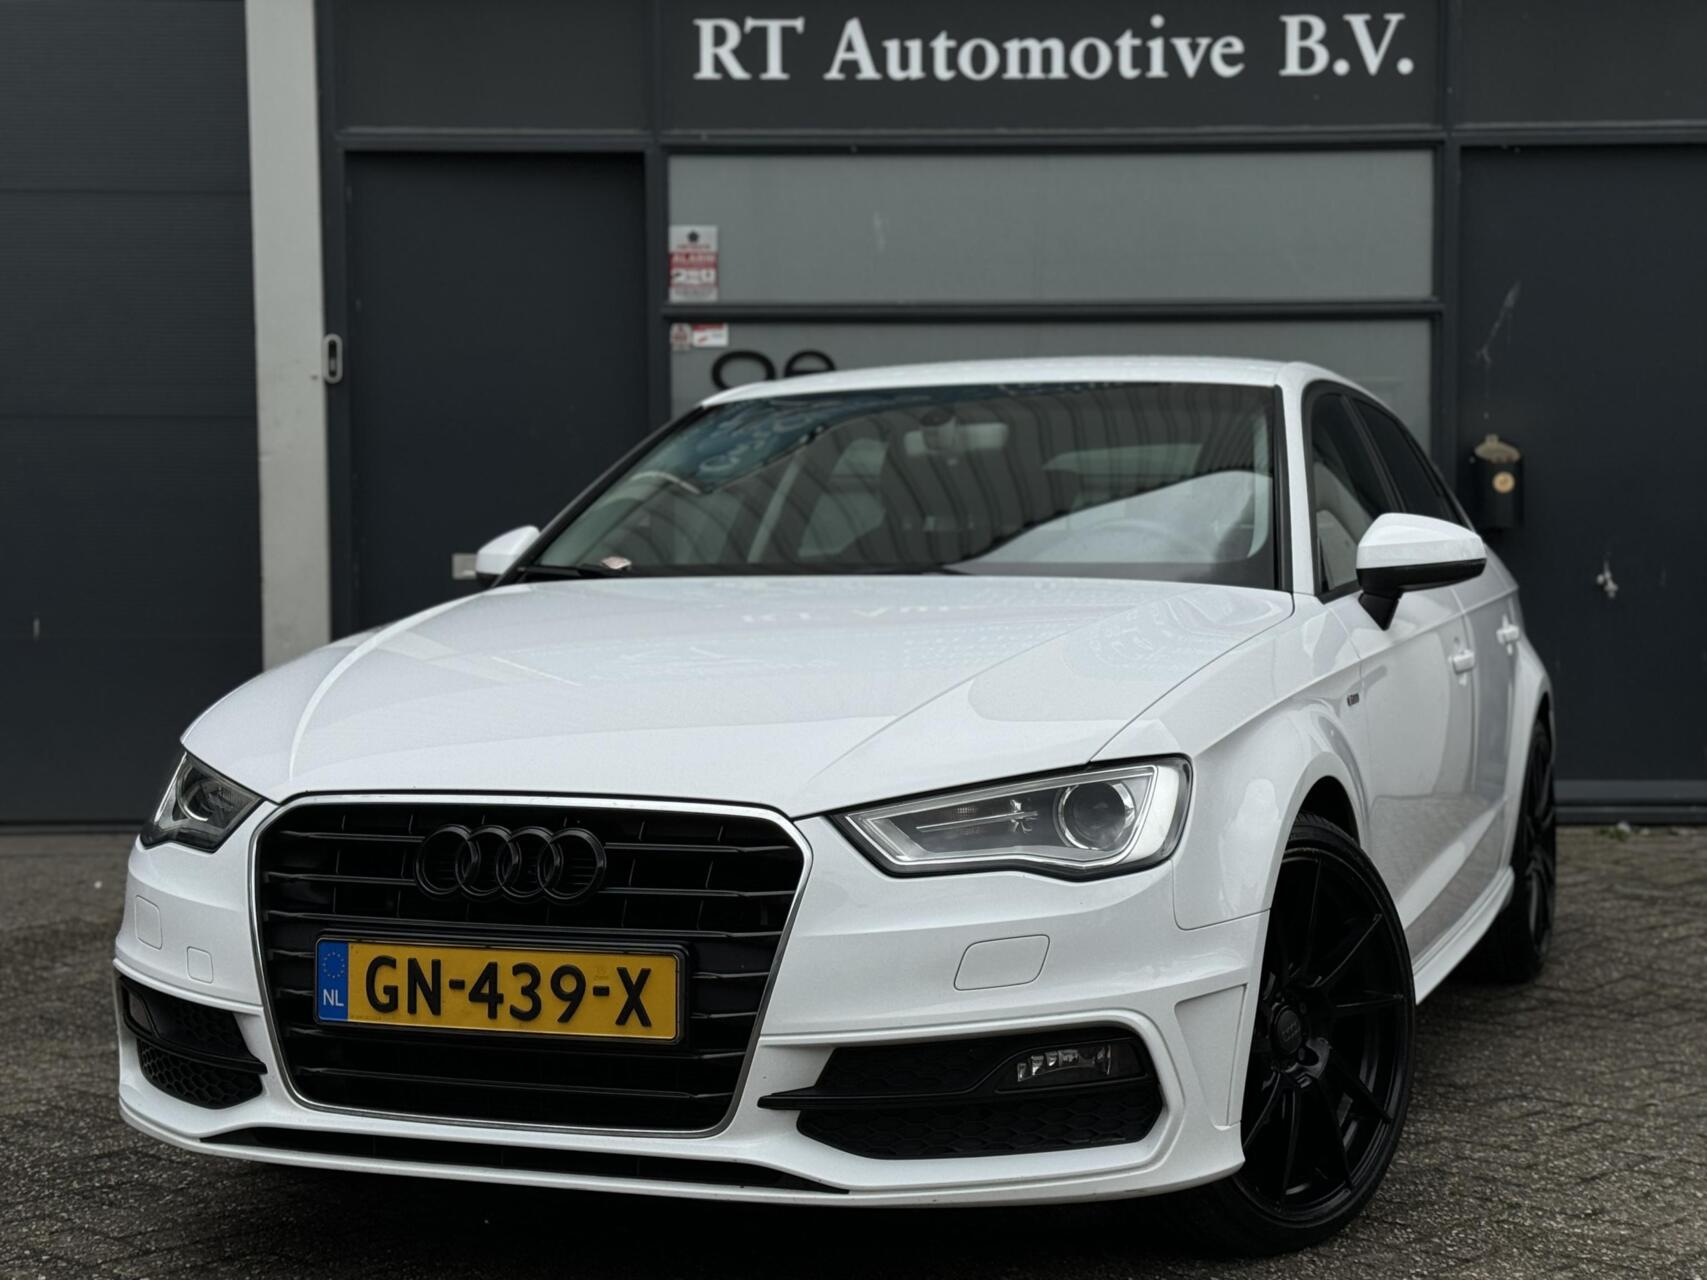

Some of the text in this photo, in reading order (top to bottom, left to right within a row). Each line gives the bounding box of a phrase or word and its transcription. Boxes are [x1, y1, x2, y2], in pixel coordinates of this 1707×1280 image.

[693, 12, 1414, 81] RT Automotive B.V.
[323, 989, 344, 1006] NL
[365, 955, 652, 1027] GN-439-X
